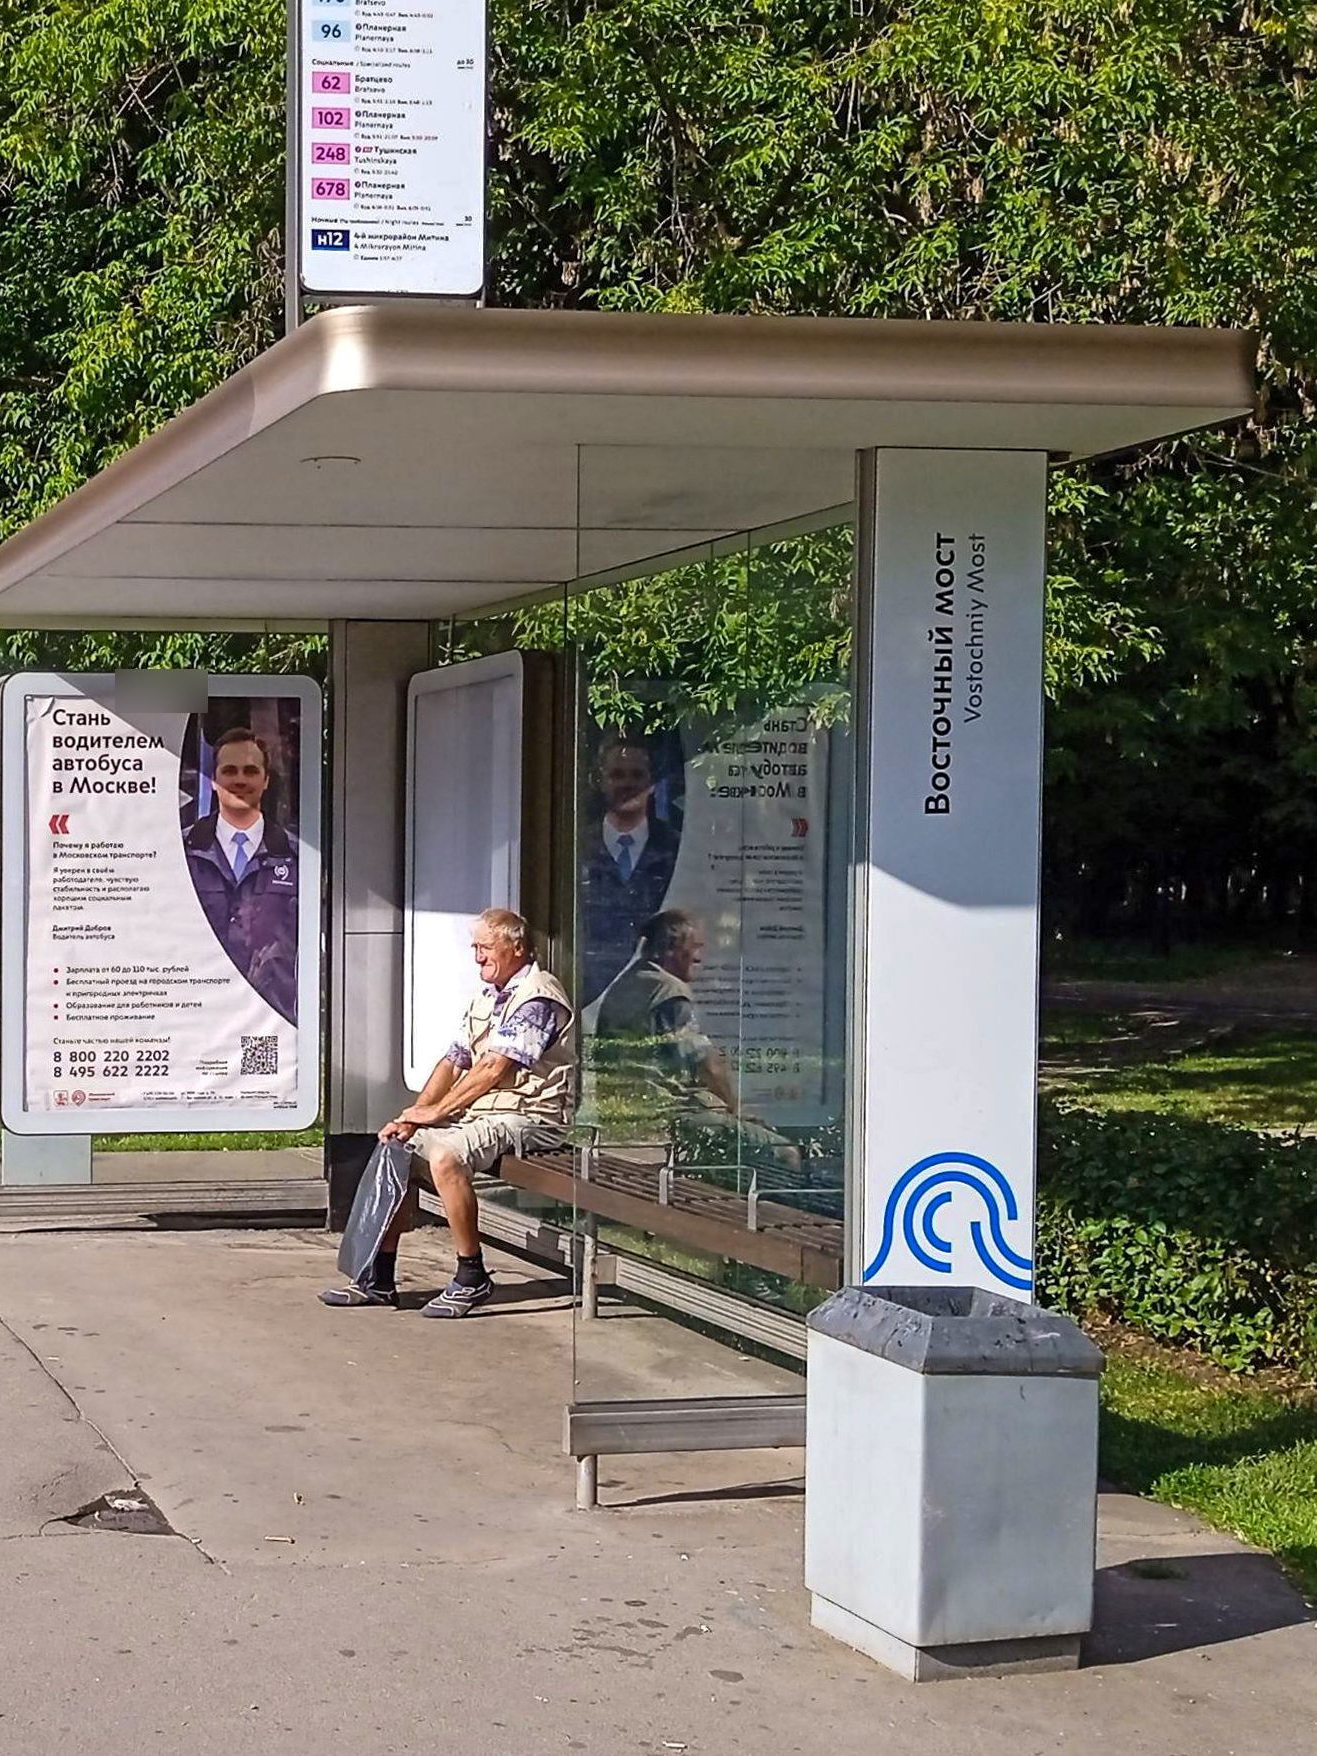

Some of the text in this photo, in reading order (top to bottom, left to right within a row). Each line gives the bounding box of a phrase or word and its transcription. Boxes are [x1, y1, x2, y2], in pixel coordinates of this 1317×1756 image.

[321, 24, 341, 38] 96
[363, 23, 406, 32] Планерная
[321, 76, 341, 90] 62
[355, 75, 393, 83] Братцево
[318, 111, 343, 125] 102
[362, 111, 406, 120] Планерная
[315, 147, 346, 161] 248
[316, 182, 346, 196] 678
[362, 181, 405, 190] Планерная
[964, 533, 988, 724] Vostochniy Most
[52, 709, 111, 725] Стань
[924, 626, 955, 815] Восточный
[52, 736, 165, 751] водителем
[52, 754, 143, 775] автобуса
[52, 777, 156, 794] в Москве!
[53, 842, 83, 850] Почему
[109, 851, 157, 859] транспорте?
[53, 1050, 170, 1062] 8 800 220 2202
[53, 1065, 169, 1077] 8 495 622 2222
